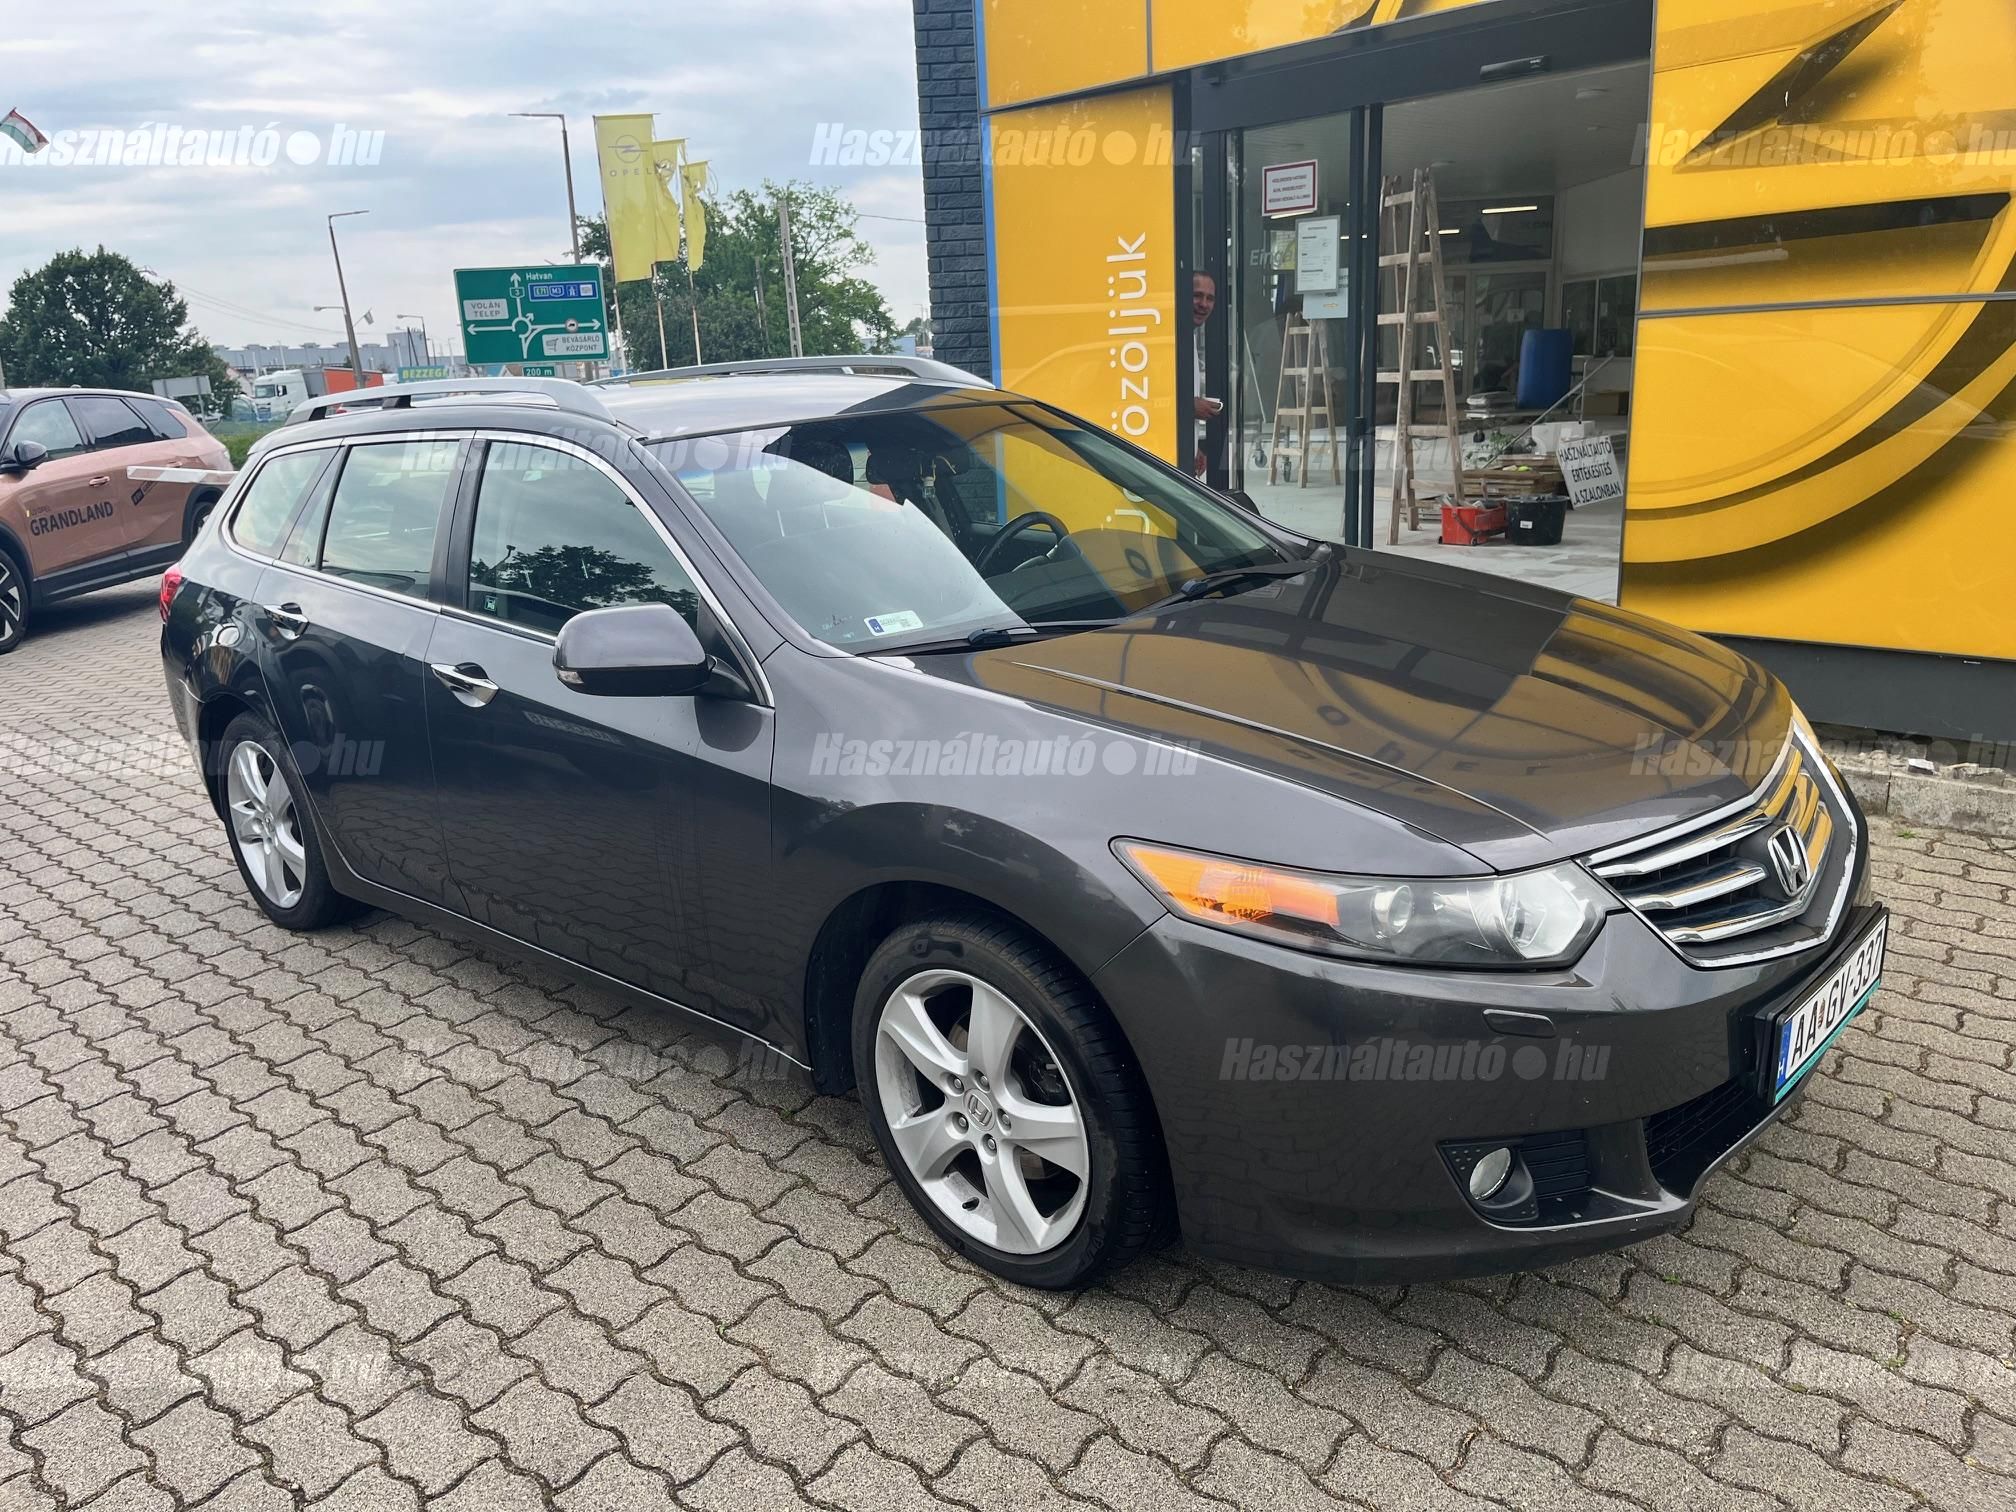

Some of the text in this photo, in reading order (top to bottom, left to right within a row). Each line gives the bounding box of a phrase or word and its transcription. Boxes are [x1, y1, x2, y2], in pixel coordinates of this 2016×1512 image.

[609, 167, 653, 177] OPEL
[525, 272, 553, 281] Hatvan
[551, 286, 562, 294] M3
[471, 301, 501, 310] VOLÁN
[474, 310, 501, 318] TELEP
[566, 344, 598, 352] KÖZPONT
[526, 367, 542, 377] 200
[1559, 438, 1612, 462] HASZNÁLTAUTÓ
[1580, 481, 1622, 504] SZALONBAN
[29, 501, 114, 537] GRANDLAND
